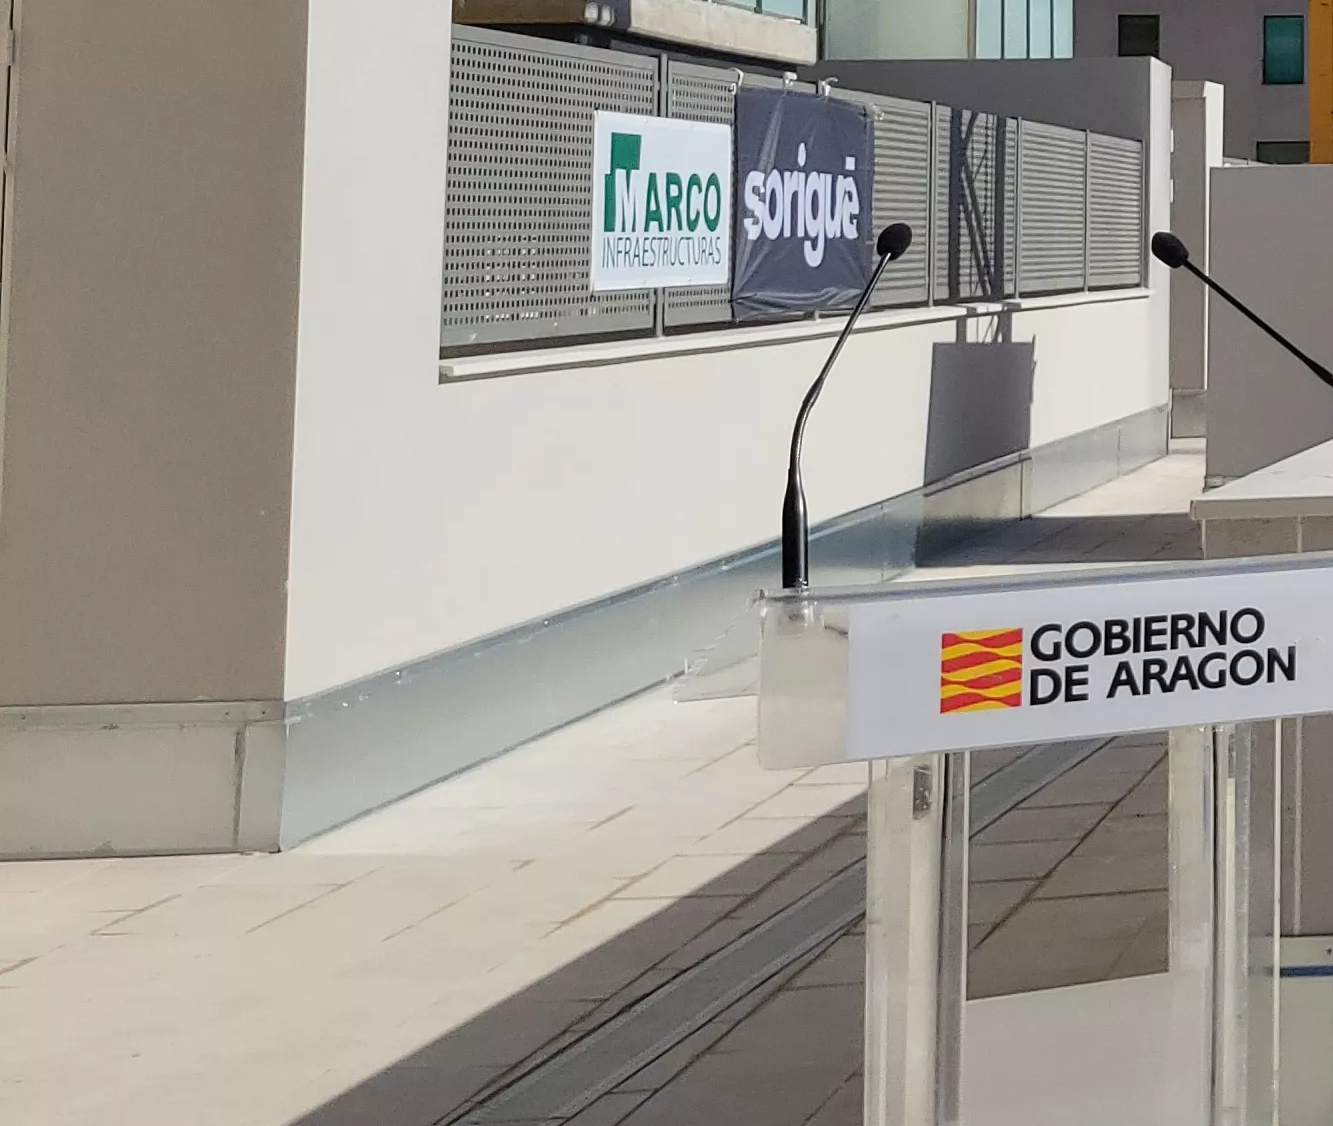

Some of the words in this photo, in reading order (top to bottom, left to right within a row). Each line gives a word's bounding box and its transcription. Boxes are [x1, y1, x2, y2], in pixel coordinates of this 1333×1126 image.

[604, 169, 722, 232] MARCO
[602, 236, 722, 268] INFRAESTRUCTURAS
[1030, 607, 1265, 662] GOBIERNO
[1029, 664, 1089, 706] DE
[1106, 646, 1296, 699] ARAGON
